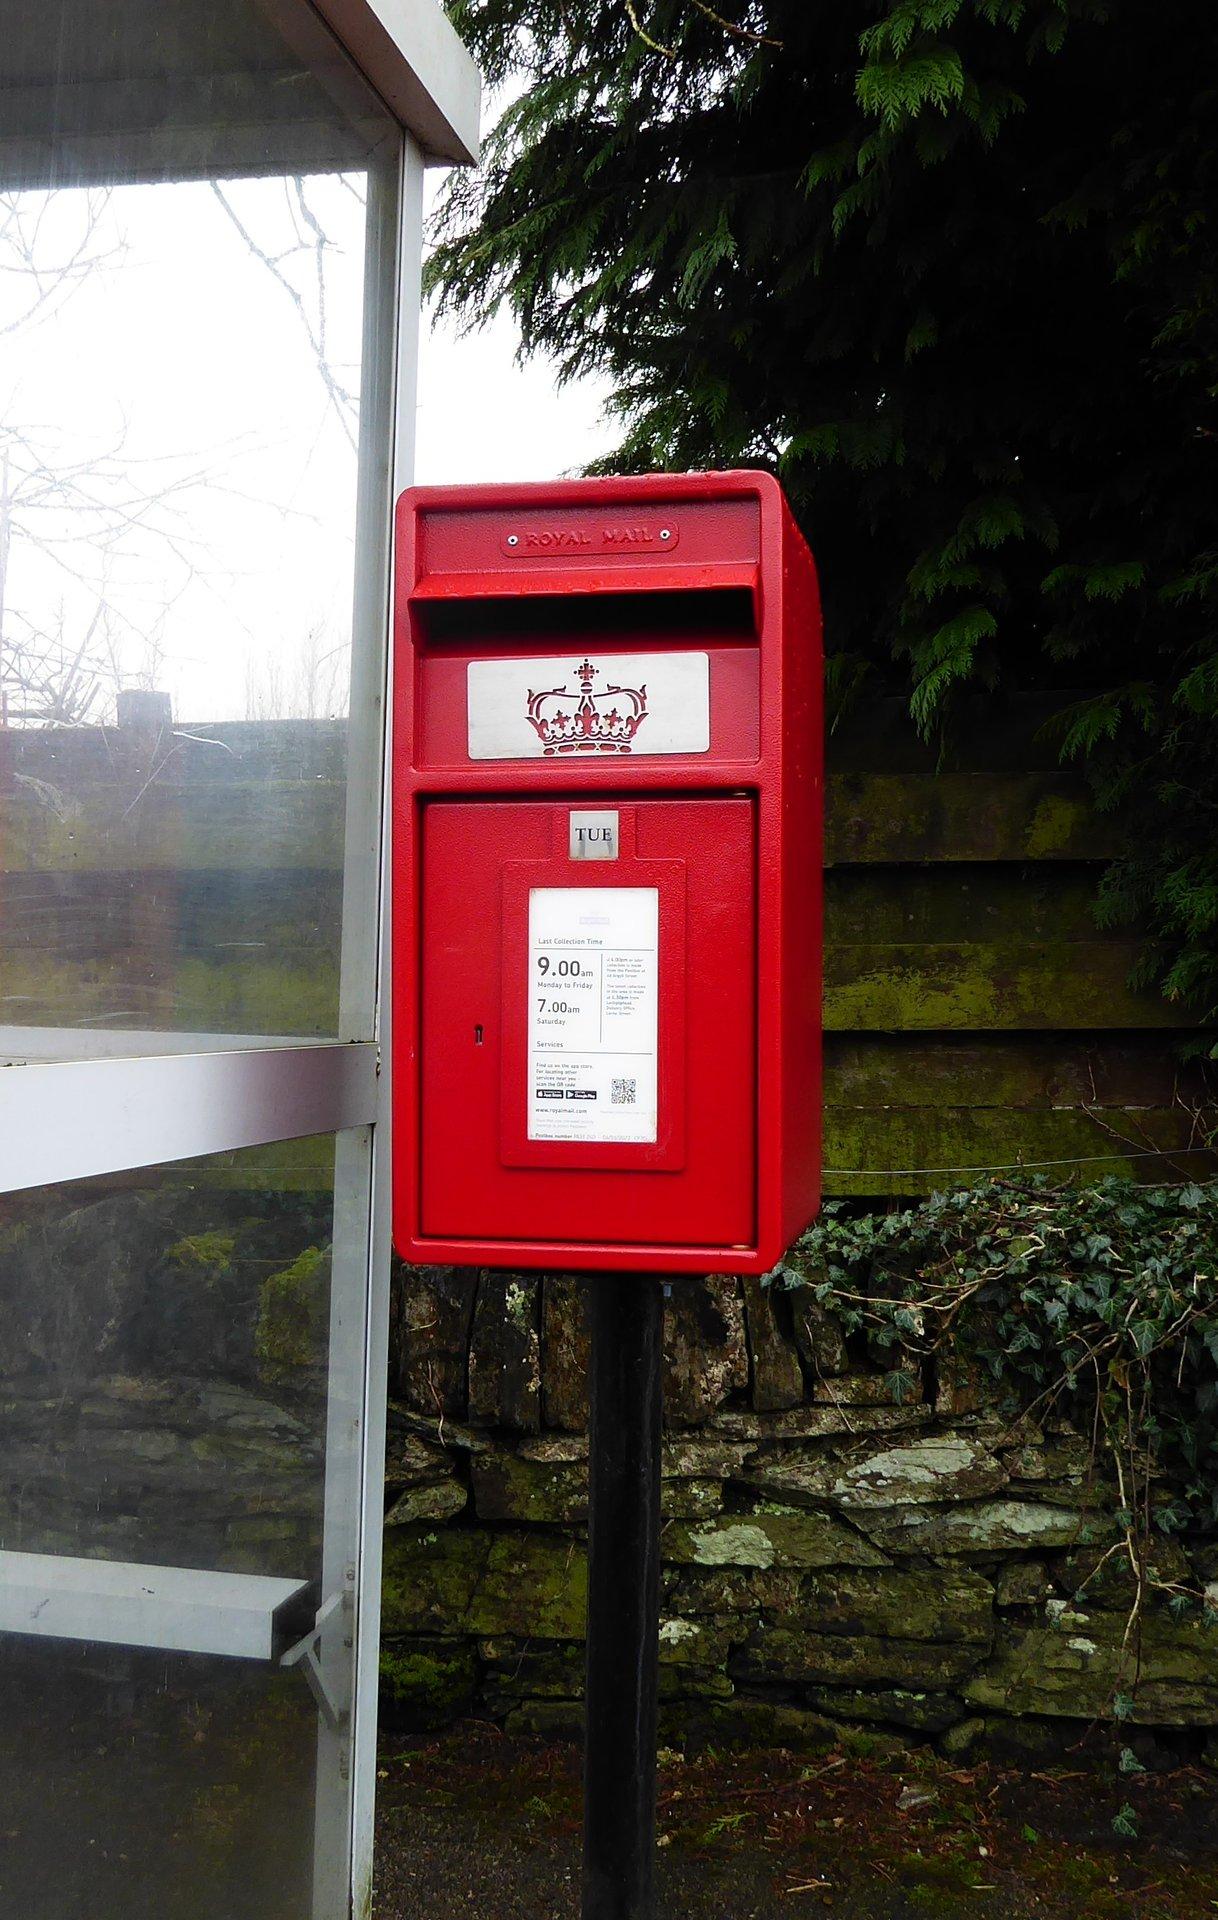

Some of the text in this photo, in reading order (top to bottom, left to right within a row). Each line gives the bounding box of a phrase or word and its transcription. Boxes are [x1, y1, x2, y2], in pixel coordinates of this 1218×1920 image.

[525, 527, 655, 547] ROYAL MAIL
[574, 827, 613, 842] TUE
[572, 982, 594, 990] Friday
[536, 1018, 567, 1026] Saturday
[536, 1040, 564, 1048] Services
